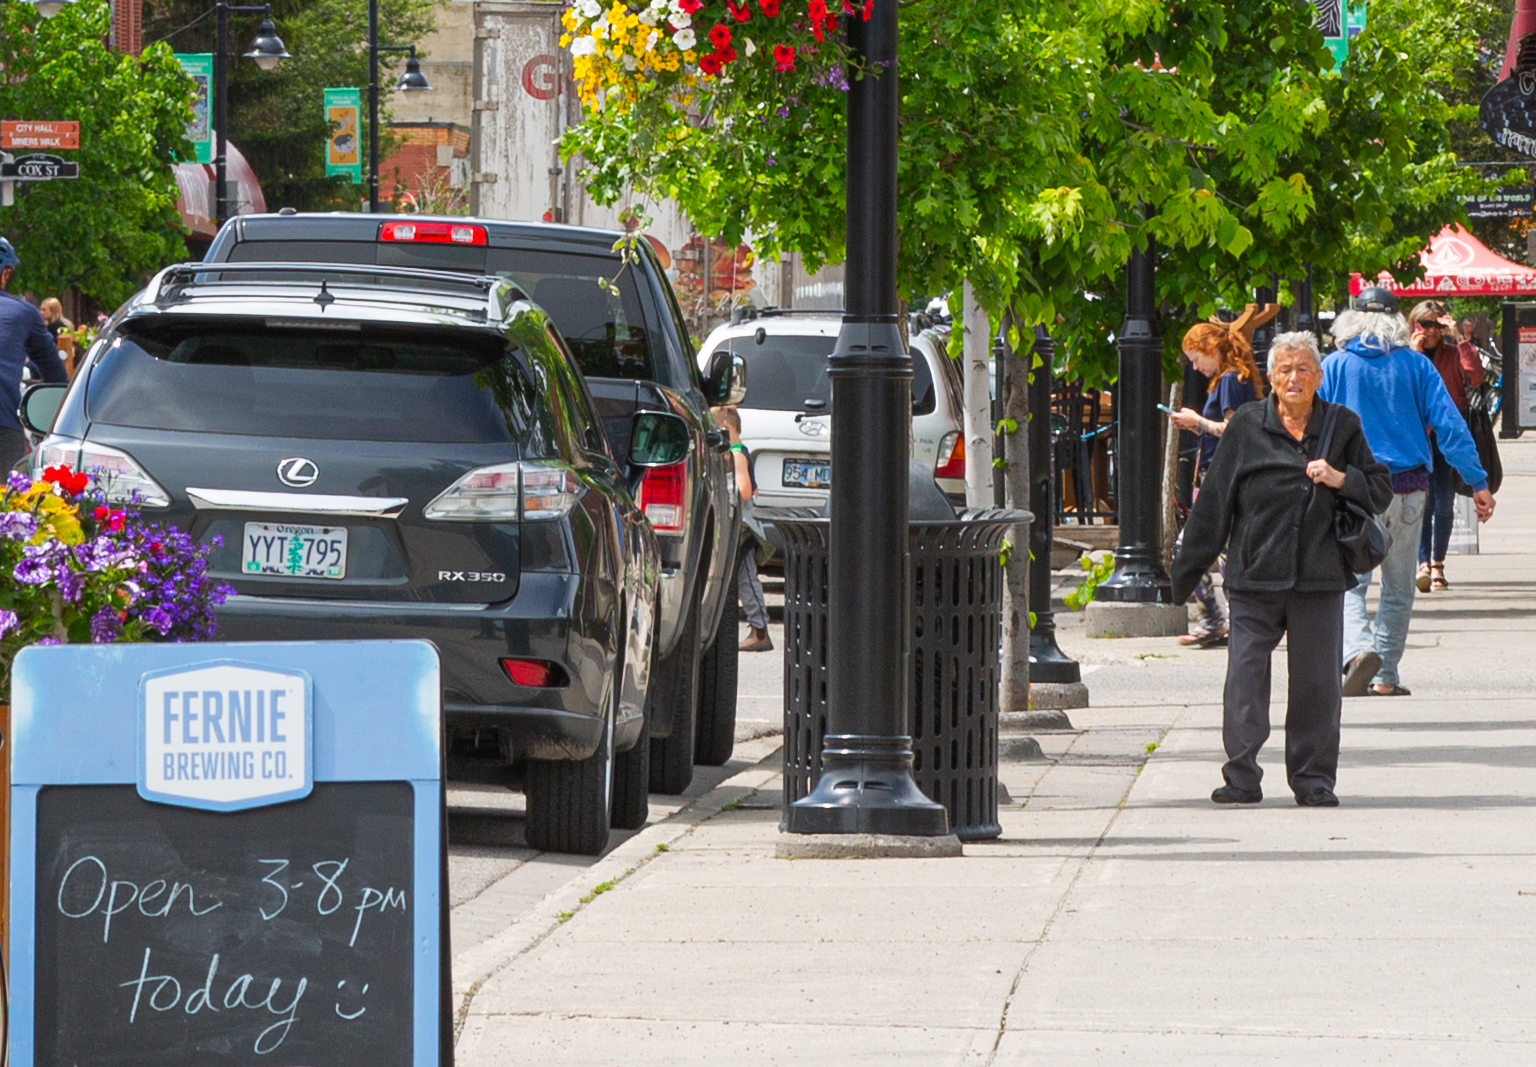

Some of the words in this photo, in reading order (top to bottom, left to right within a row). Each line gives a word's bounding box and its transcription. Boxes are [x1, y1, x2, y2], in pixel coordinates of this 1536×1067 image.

[15, 124, 33, 133] CITY
[34, 124, 54, 133] HALL
[11, 137, 38, 146] MINERS
[39, 137, 61, 146] WALK
[17, 165, 43, 177] COX
[45, 165, 60, 177] ST
[785, 465, 808, 481] 954
[814, 467, 831, 482] MD
[276, 525, 314, 537] Oregon
[249, 535, 288, 564] YYT
[303, 538, 342, 567] 795
[438, 570, 466, 582] RX
[467, 571, 506, 583] 350
[163, 689, 287, 744] FERNIE
[163, 751, 254, 781] BREWING
[261, 750, 293, 780] CO.
[58, 855, 223, 943] Open
[119, 947, 308, 1054] today
